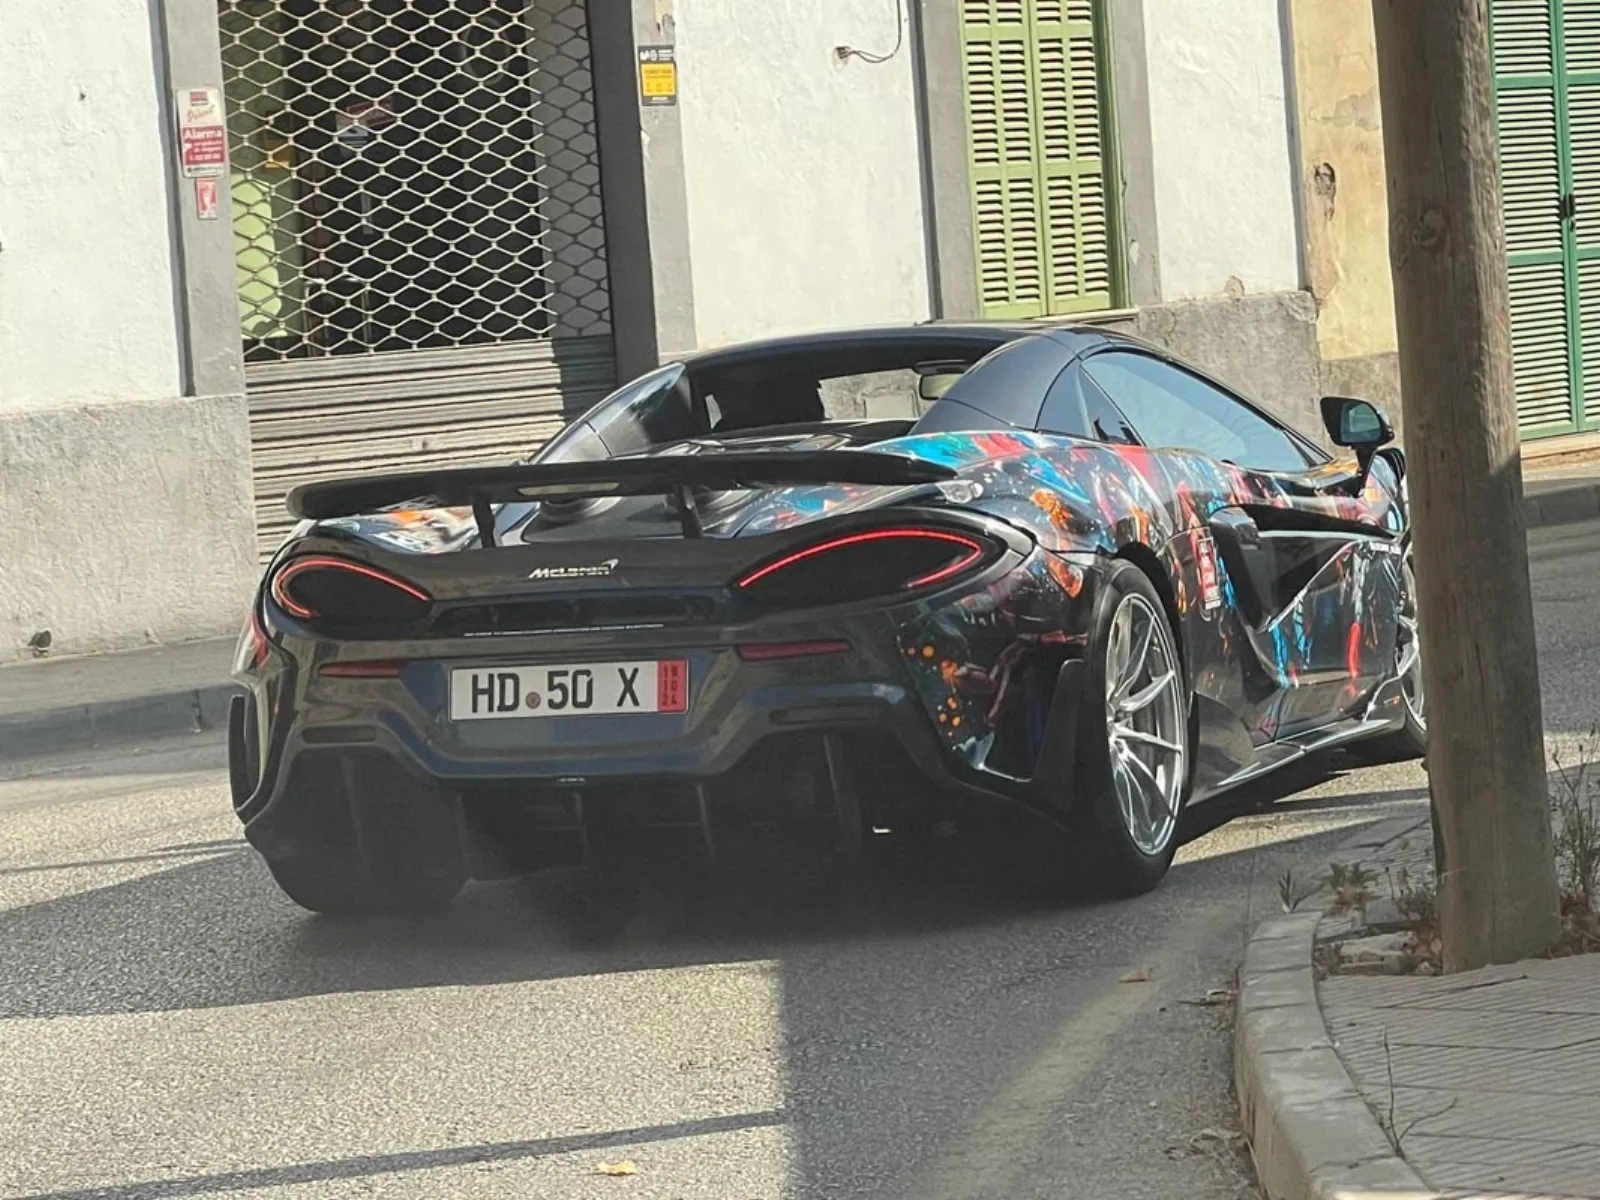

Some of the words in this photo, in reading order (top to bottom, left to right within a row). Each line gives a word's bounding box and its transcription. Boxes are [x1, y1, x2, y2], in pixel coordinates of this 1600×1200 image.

[184, 128, 222, 139] Alarma
[528, 565, 611, 579] McLaren
[471, 672, 520, 713] HD
[547, 669, 594, 710] 50
[616, 667, 640, 707] X
